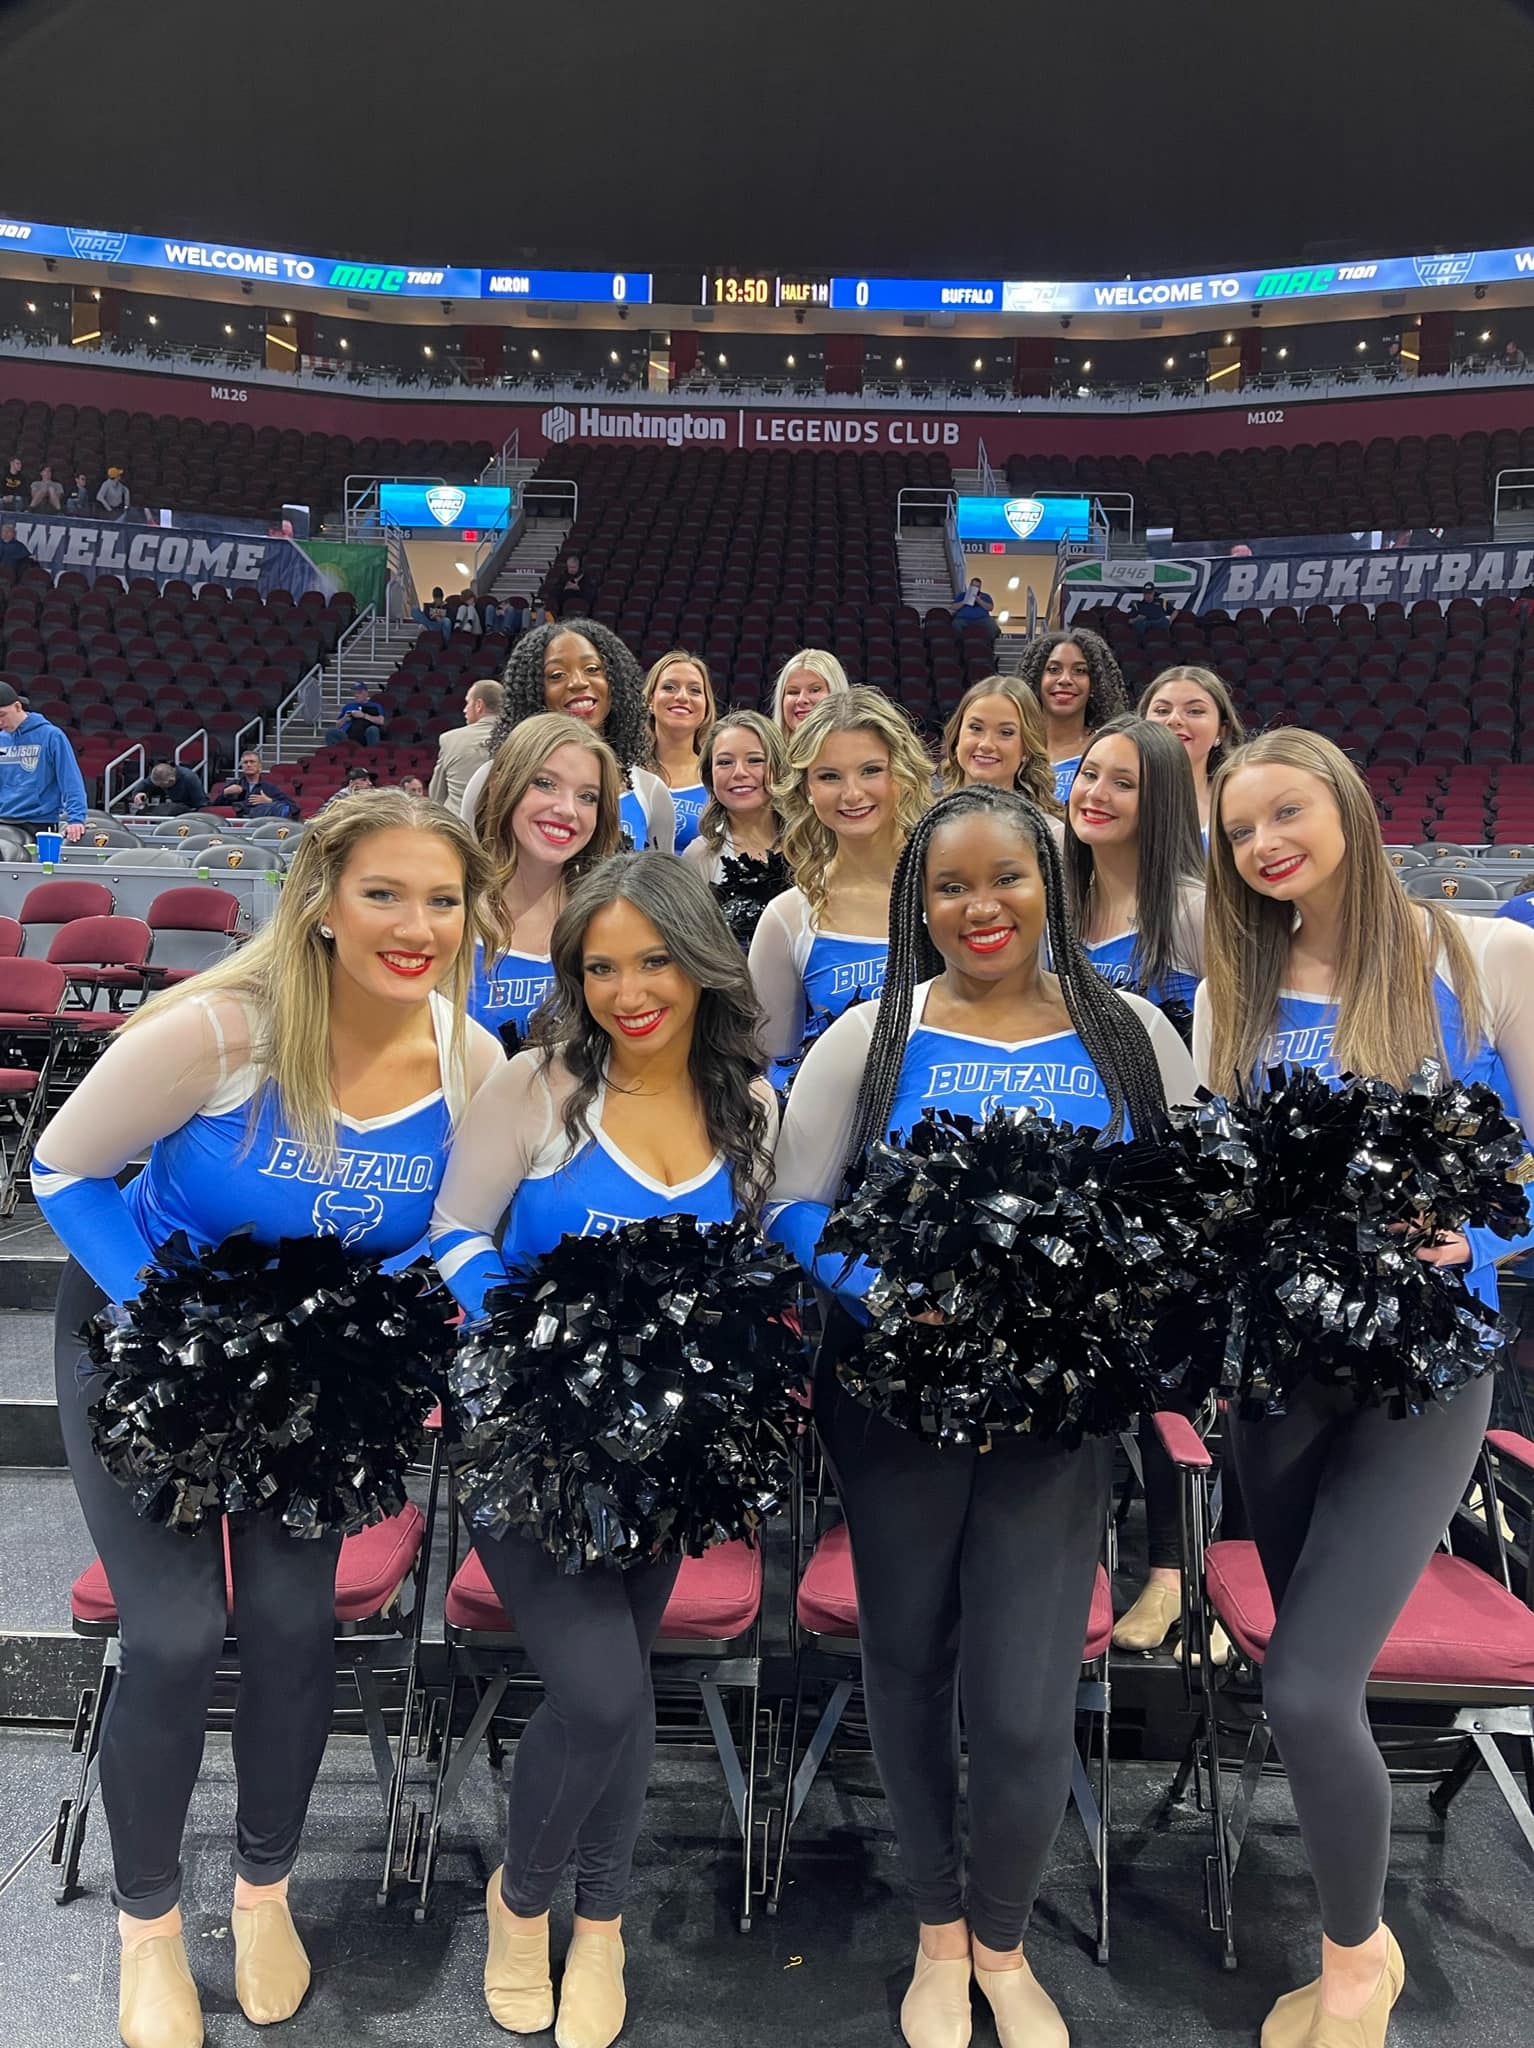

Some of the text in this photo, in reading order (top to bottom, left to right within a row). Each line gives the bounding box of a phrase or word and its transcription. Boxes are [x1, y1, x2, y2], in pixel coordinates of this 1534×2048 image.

[164, 243, 279, 277] WELCOME
[283, 259, 316, 280] TO
[489, 276, 529, 293] AKRON
[612, 274, 626, 300] 0
[714, 278, 768, 303] 13:50
[780, 284, 810, 302] HALF
[856, 281, 869, 306] 0
[941, 288, 994, 304] BUFFALO
[1094, 281, 1203, 305] WELCOME
[1208, 278, 1240, 299] TO
[211, 385, 248, 402] M126
[579, 407, 960, 447] Huntington LEGENDS CLUB
[1247, 410, 1284, 425] M102
[15, 522, 265, 581] WELCOME
[1110, 566, 1149, 579] 1946
[921, 1063, 1097, 1098] BUFFALO
